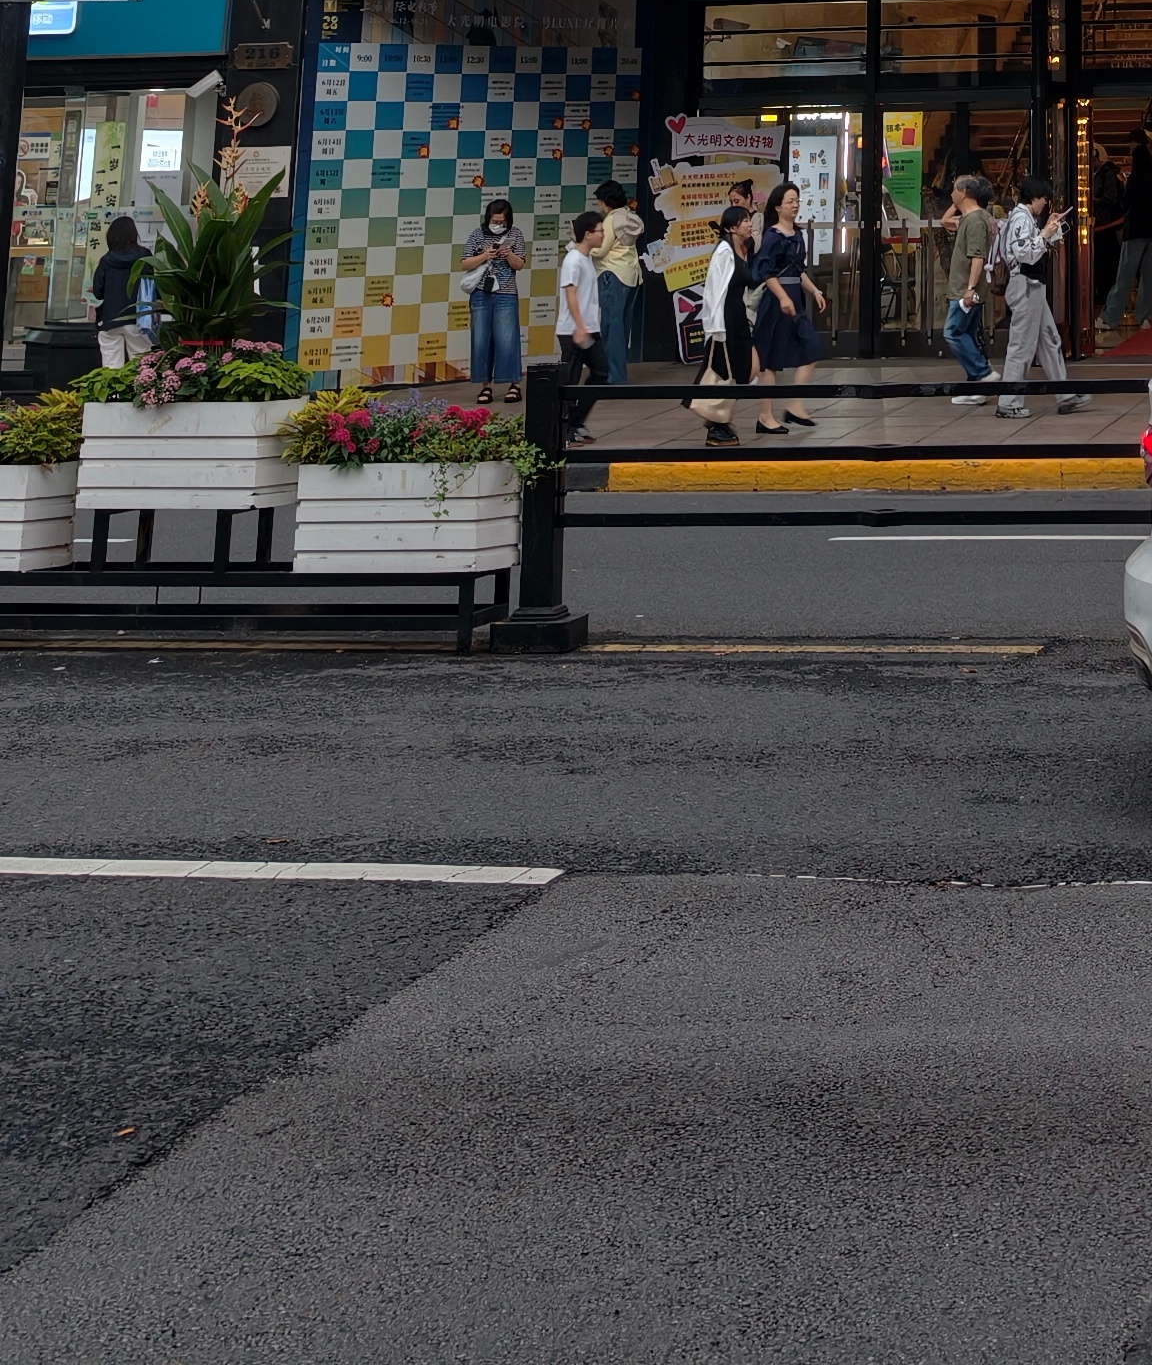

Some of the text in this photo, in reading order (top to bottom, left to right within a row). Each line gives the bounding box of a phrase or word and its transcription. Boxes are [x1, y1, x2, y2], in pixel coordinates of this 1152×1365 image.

[322, 15, 339, 30] 28
[244, 46, 281, 60] 216
[356, 54, 373, 63] 9:00
[683, 133, 774, 148] 大光明文创好物
